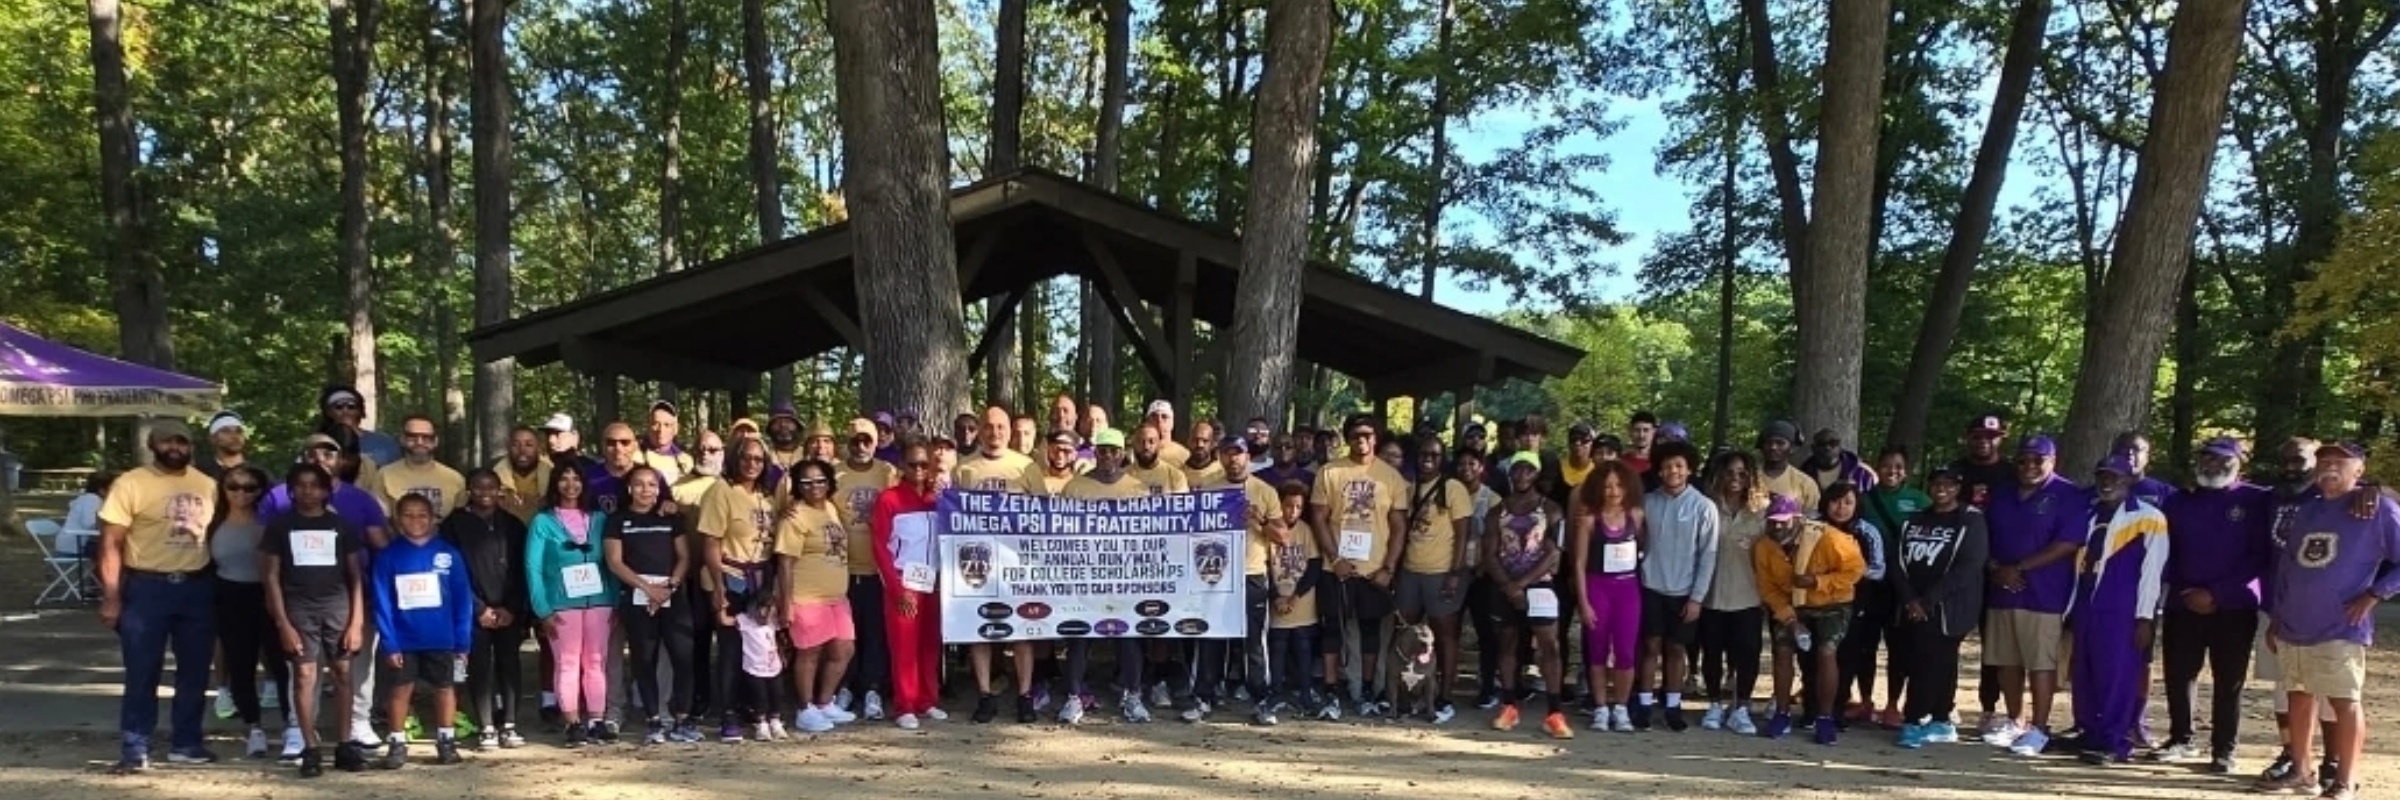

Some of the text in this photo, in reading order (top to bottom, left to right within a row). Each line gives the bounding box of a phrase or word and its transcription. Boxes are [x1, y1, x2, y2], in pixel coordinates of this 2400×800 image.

[959, 492, 1224, 513] THE ZETA OMEGA CHAPTER OF
[951, 511, 1232, 534] OMEGA PSI PHI FRATERNITY, INC.
[1019, 538, 1167, 552] WELCOMES YOU TO OUR
[1044, 554, 1095, 566] ANNUAL
[1098, 551, 1169, 566] RUN/WALK
[1003, 565, 1184, 582] FOR COLLEGE SCHOLARSHIPS
[1011, 581, 1176, 596] THANK YOU TO OUR SPONSORS
